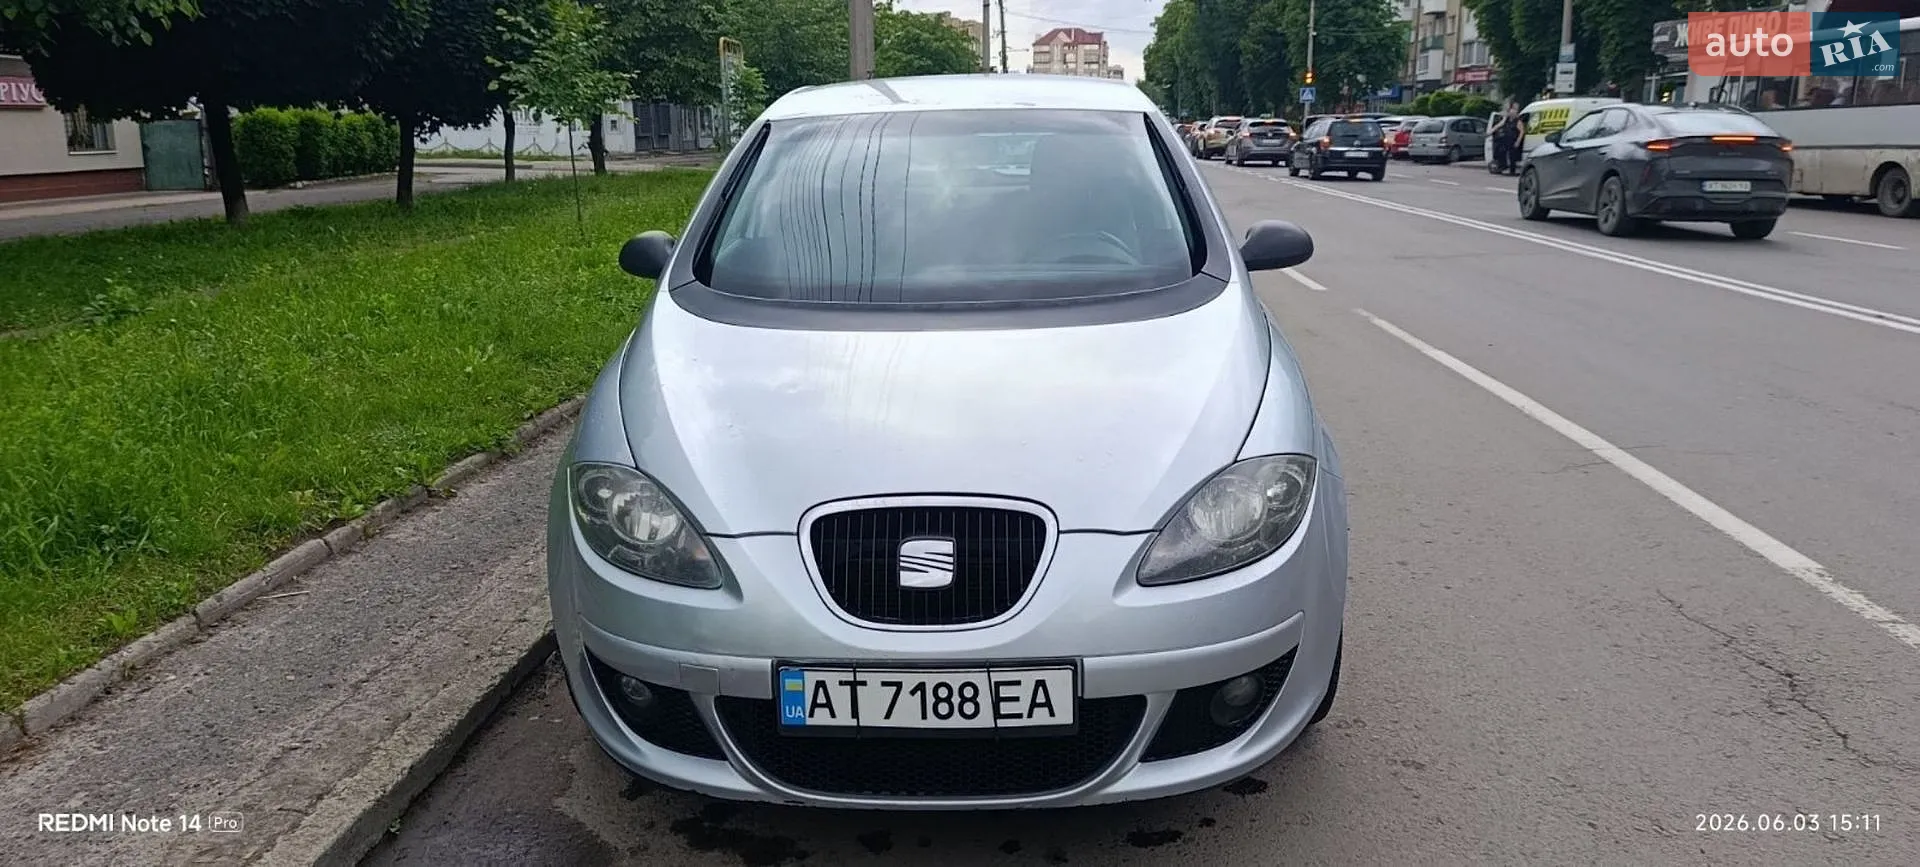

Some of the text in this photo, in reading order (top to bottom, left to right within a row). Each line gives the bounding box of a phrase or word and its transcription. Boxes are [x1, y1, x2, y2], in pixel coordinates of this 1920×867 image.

[785, 704, 804, 718] UA
[808, 679, 1056, 720] AT 7188 EA
